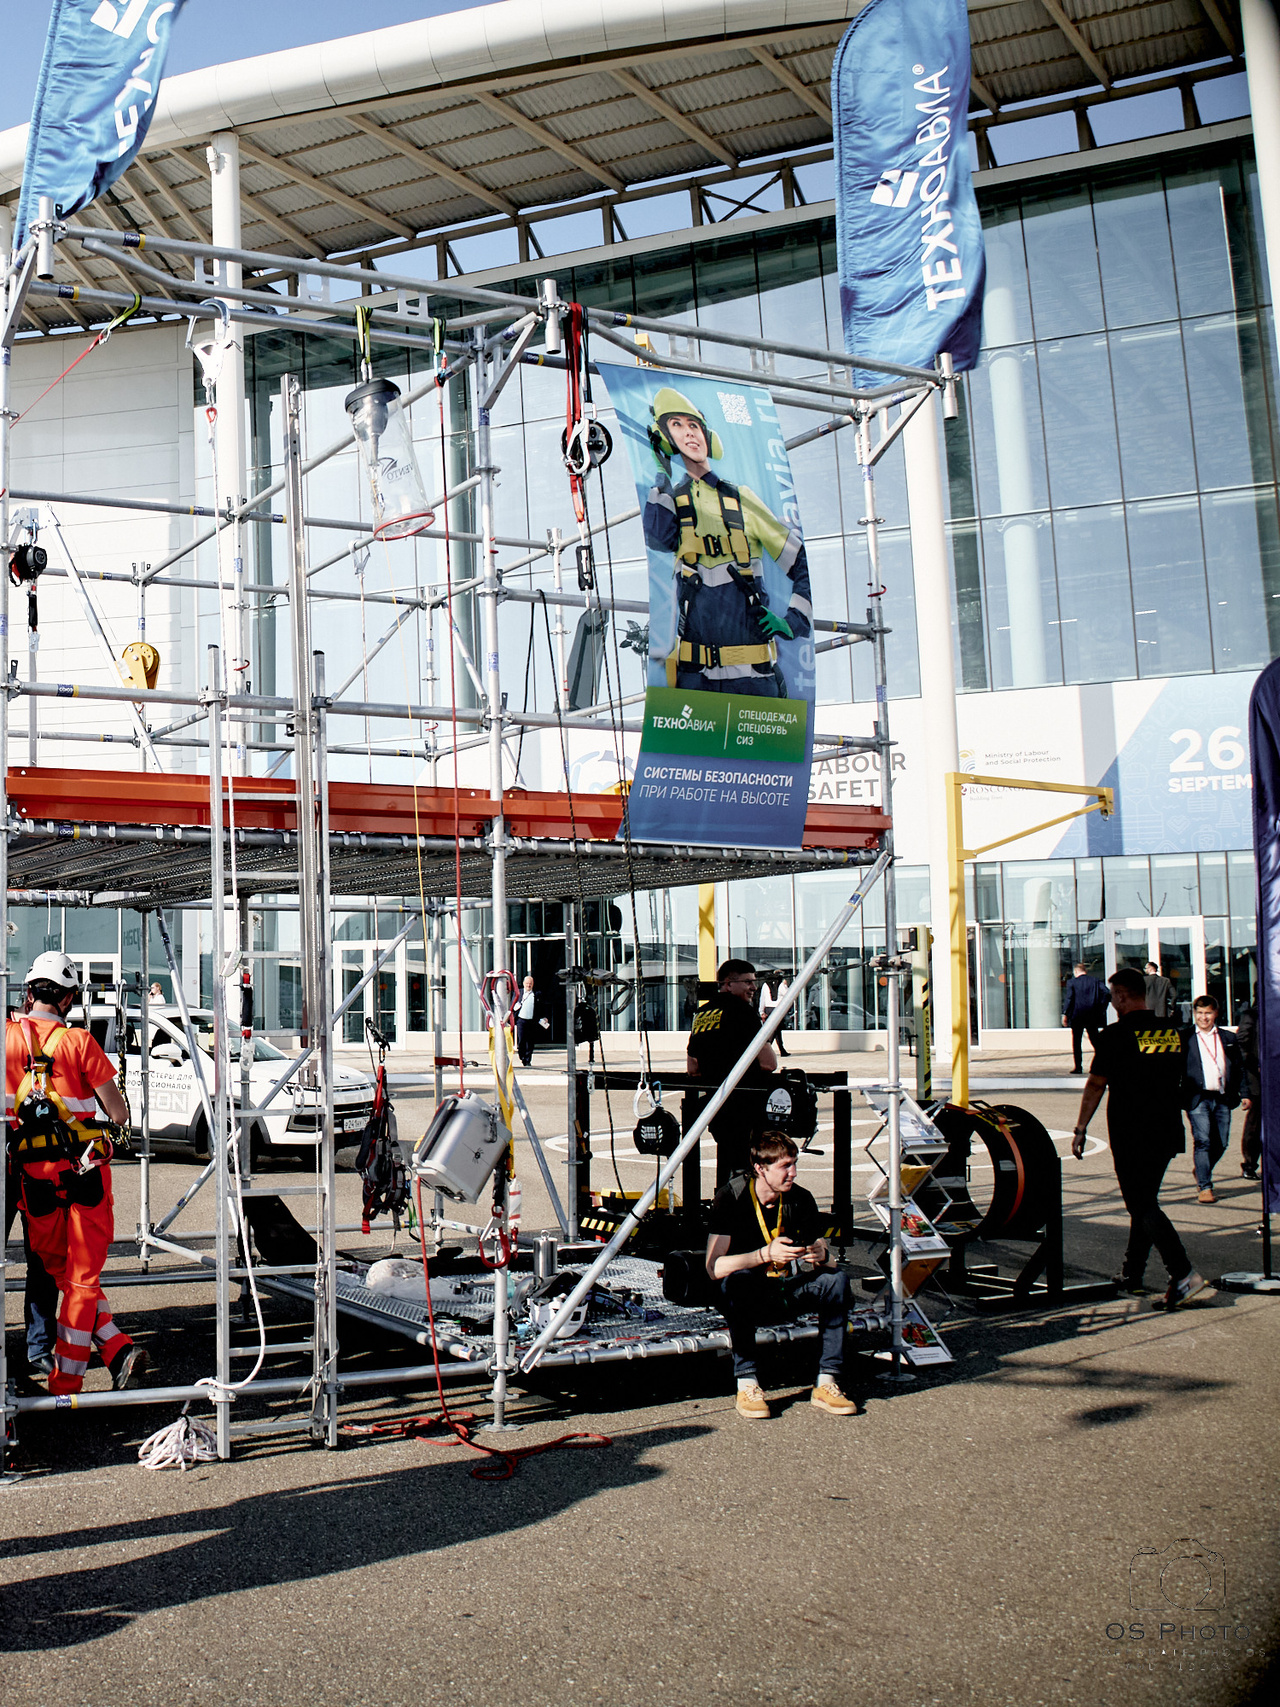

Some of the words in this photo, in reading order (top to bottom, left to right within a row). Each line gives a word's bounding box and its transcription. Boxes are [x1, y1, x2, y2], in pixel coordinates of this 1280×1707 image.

[738, 709, 798, 724] СПЕЦОДЕЖДА
[737, 722, 787, 736] СПЕЦОБУВЬ
[736, 735, 754, 746] СИЗ
[1169, 725, 1245, 773] 26
[985, 751, 1013, 759] Ministry
[1023, 756, 1061, 764] Protection
[811, 752, 907, 776] ABOUR
[643, 766, 703, 782] СИСТЕМЫ
[704, 770, 794, 787] БЕЗОПАСНОСТИ
[1168, 774, 1253, 793] SEPTEM
[639, 784, 667, 799] ПРИ
[669, 786, 718, 802] РАБОТЕ
[720, 789, 737, 804] НА
[741, 790, 791, 806] ВЫСОТЕ
